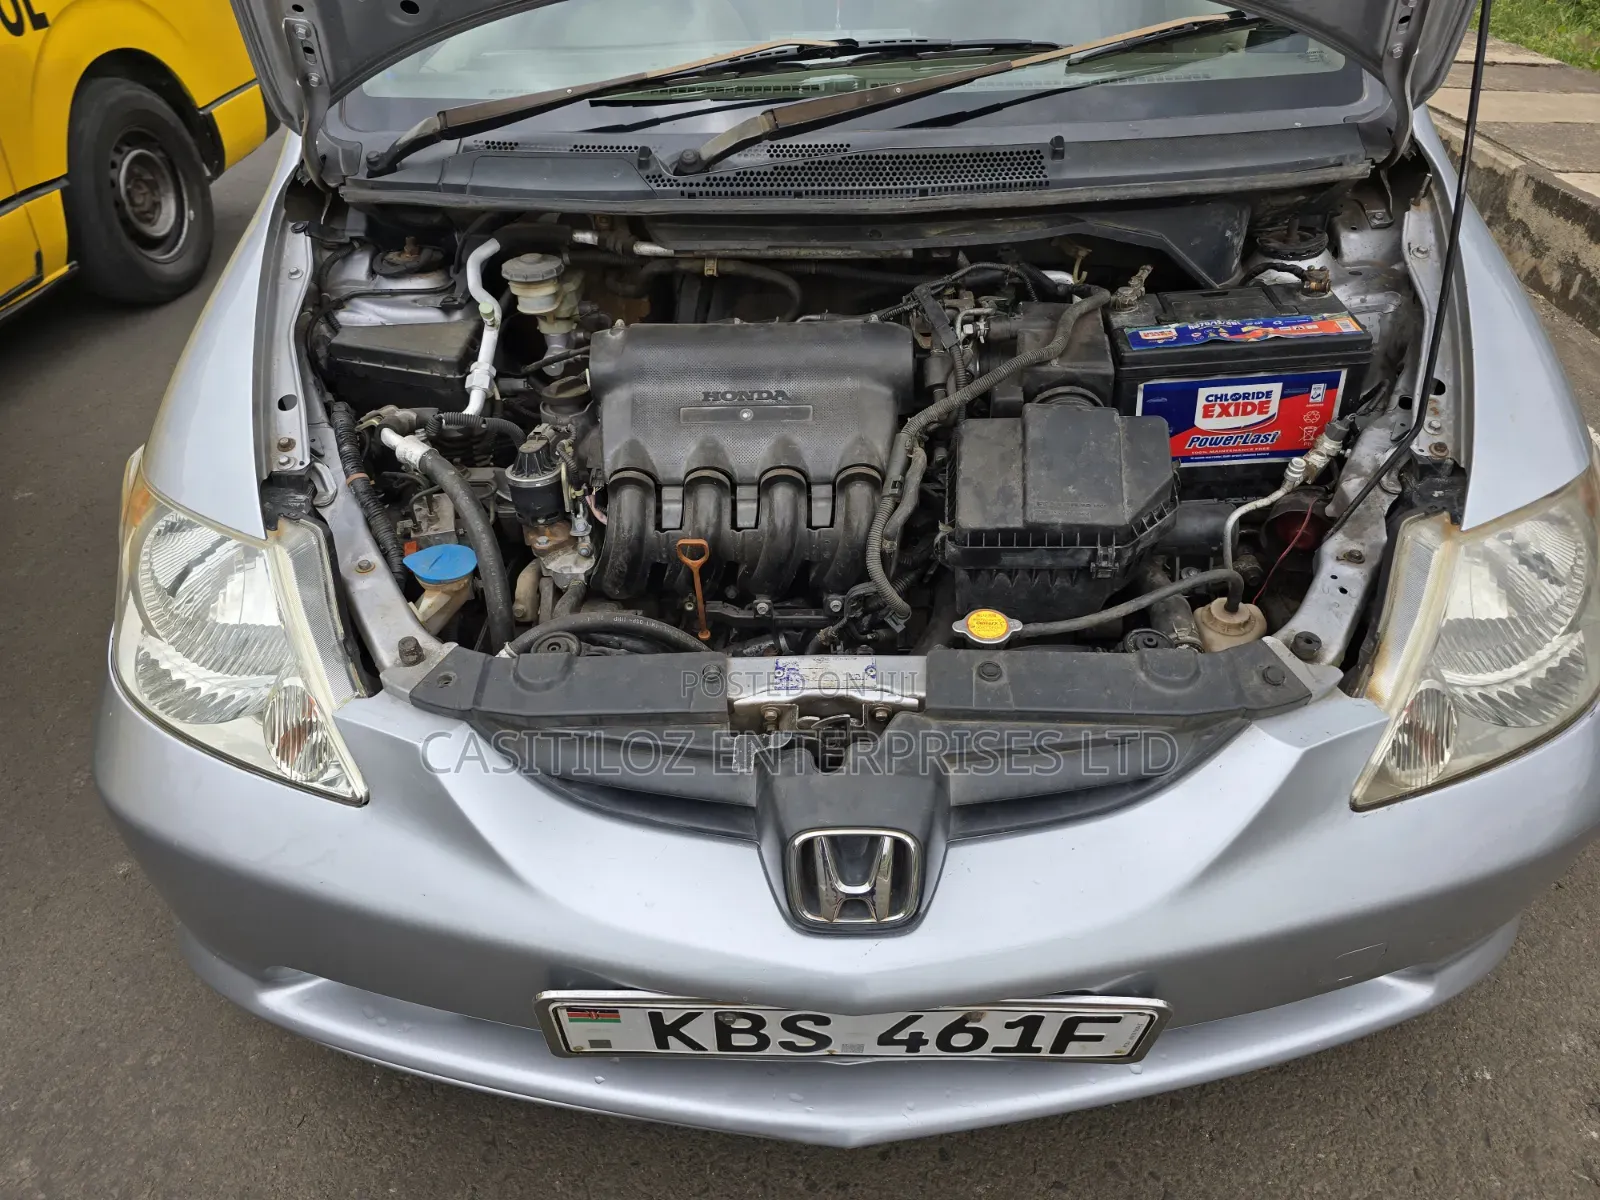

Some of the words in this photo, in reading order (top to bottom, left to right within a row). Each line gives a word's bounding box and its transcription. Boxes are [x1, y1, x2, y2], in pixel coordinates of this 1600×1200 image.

[701, 389, 791, 402] HONDA
[1205, 390, 1273, 403] CHLORIDE
[1201, 400, 1272, 419] EXIDE
[648, 1010, 834, 1053] KBS
[877, 1013, 1123, 1054] 461F
